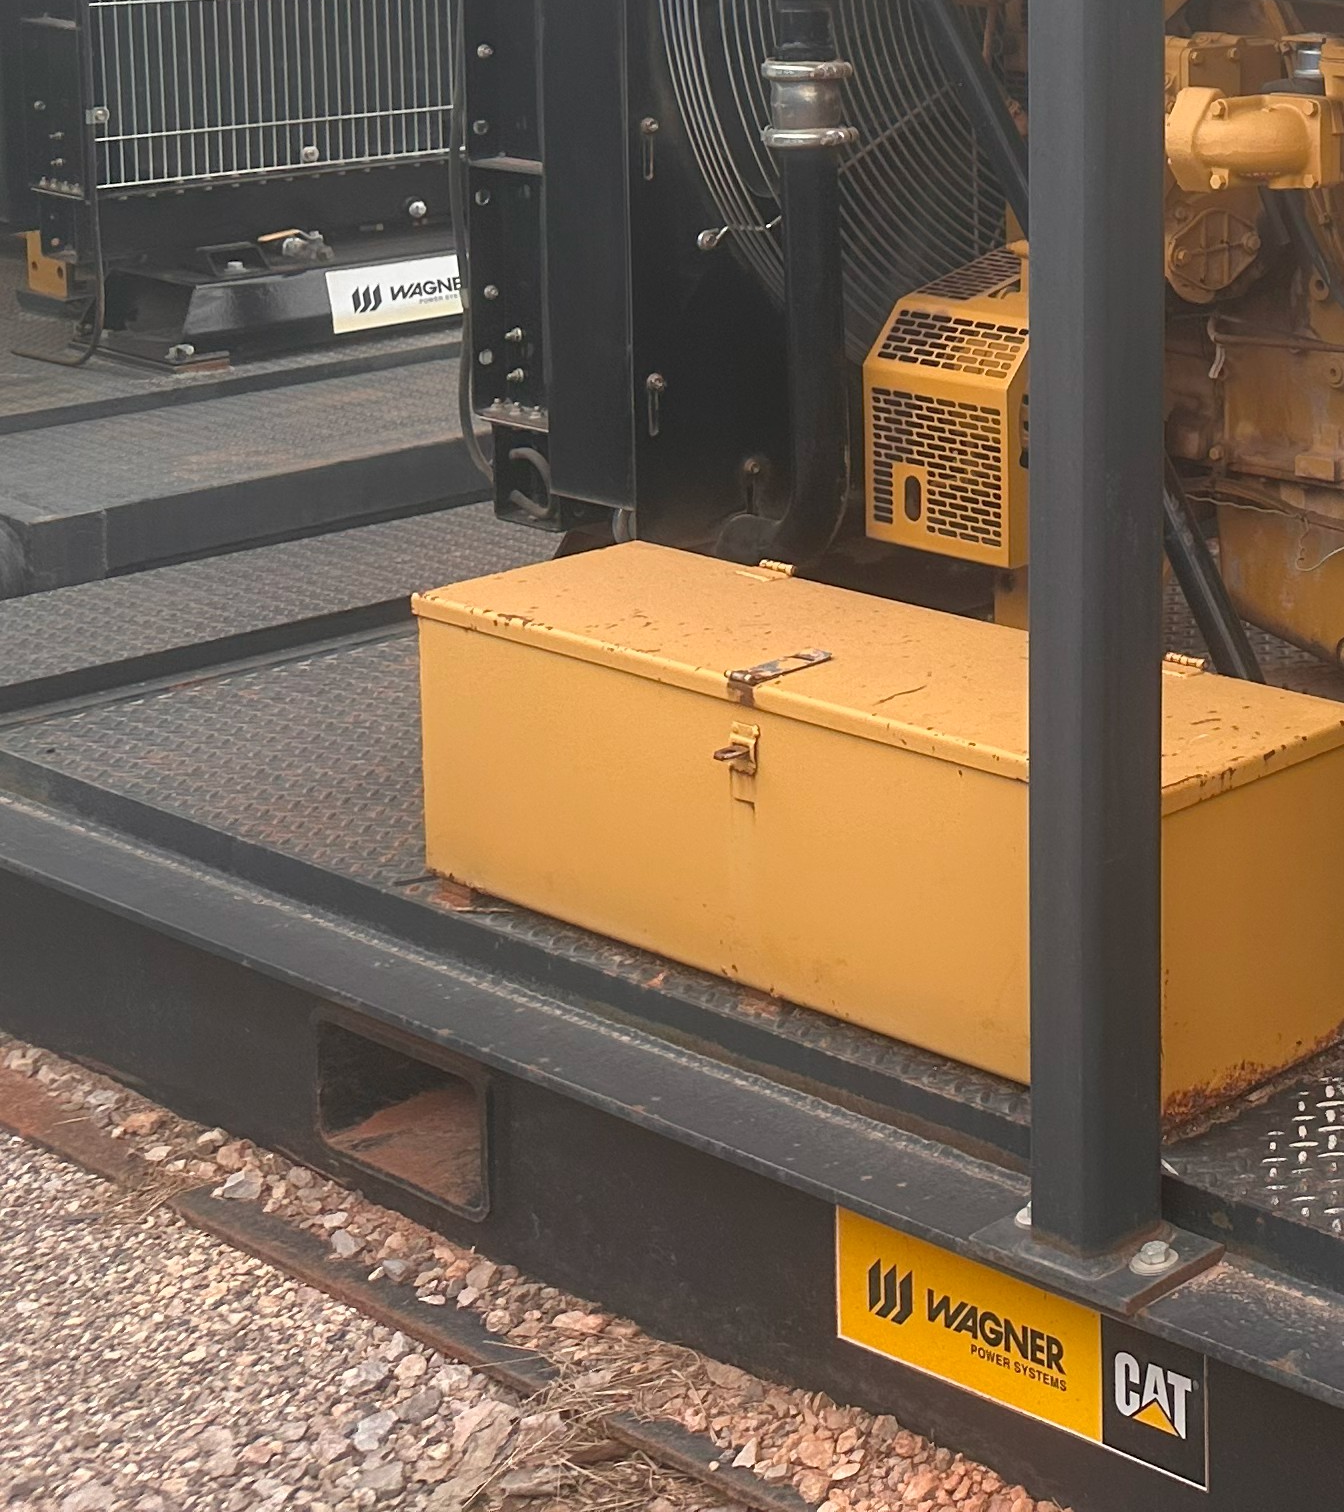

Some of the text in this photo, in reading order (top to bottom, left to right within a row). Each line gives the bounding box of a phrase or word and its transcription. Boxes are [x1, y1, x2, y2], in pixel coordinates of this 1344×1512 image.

[390, 276, 462, 301] WAGNE
[927, 1288, 1067, 1375] WAGNER
[970, 1344, 1068, 1393] POWER SYSTEMS
[1114, 1351, 1193, 1440] CAT
